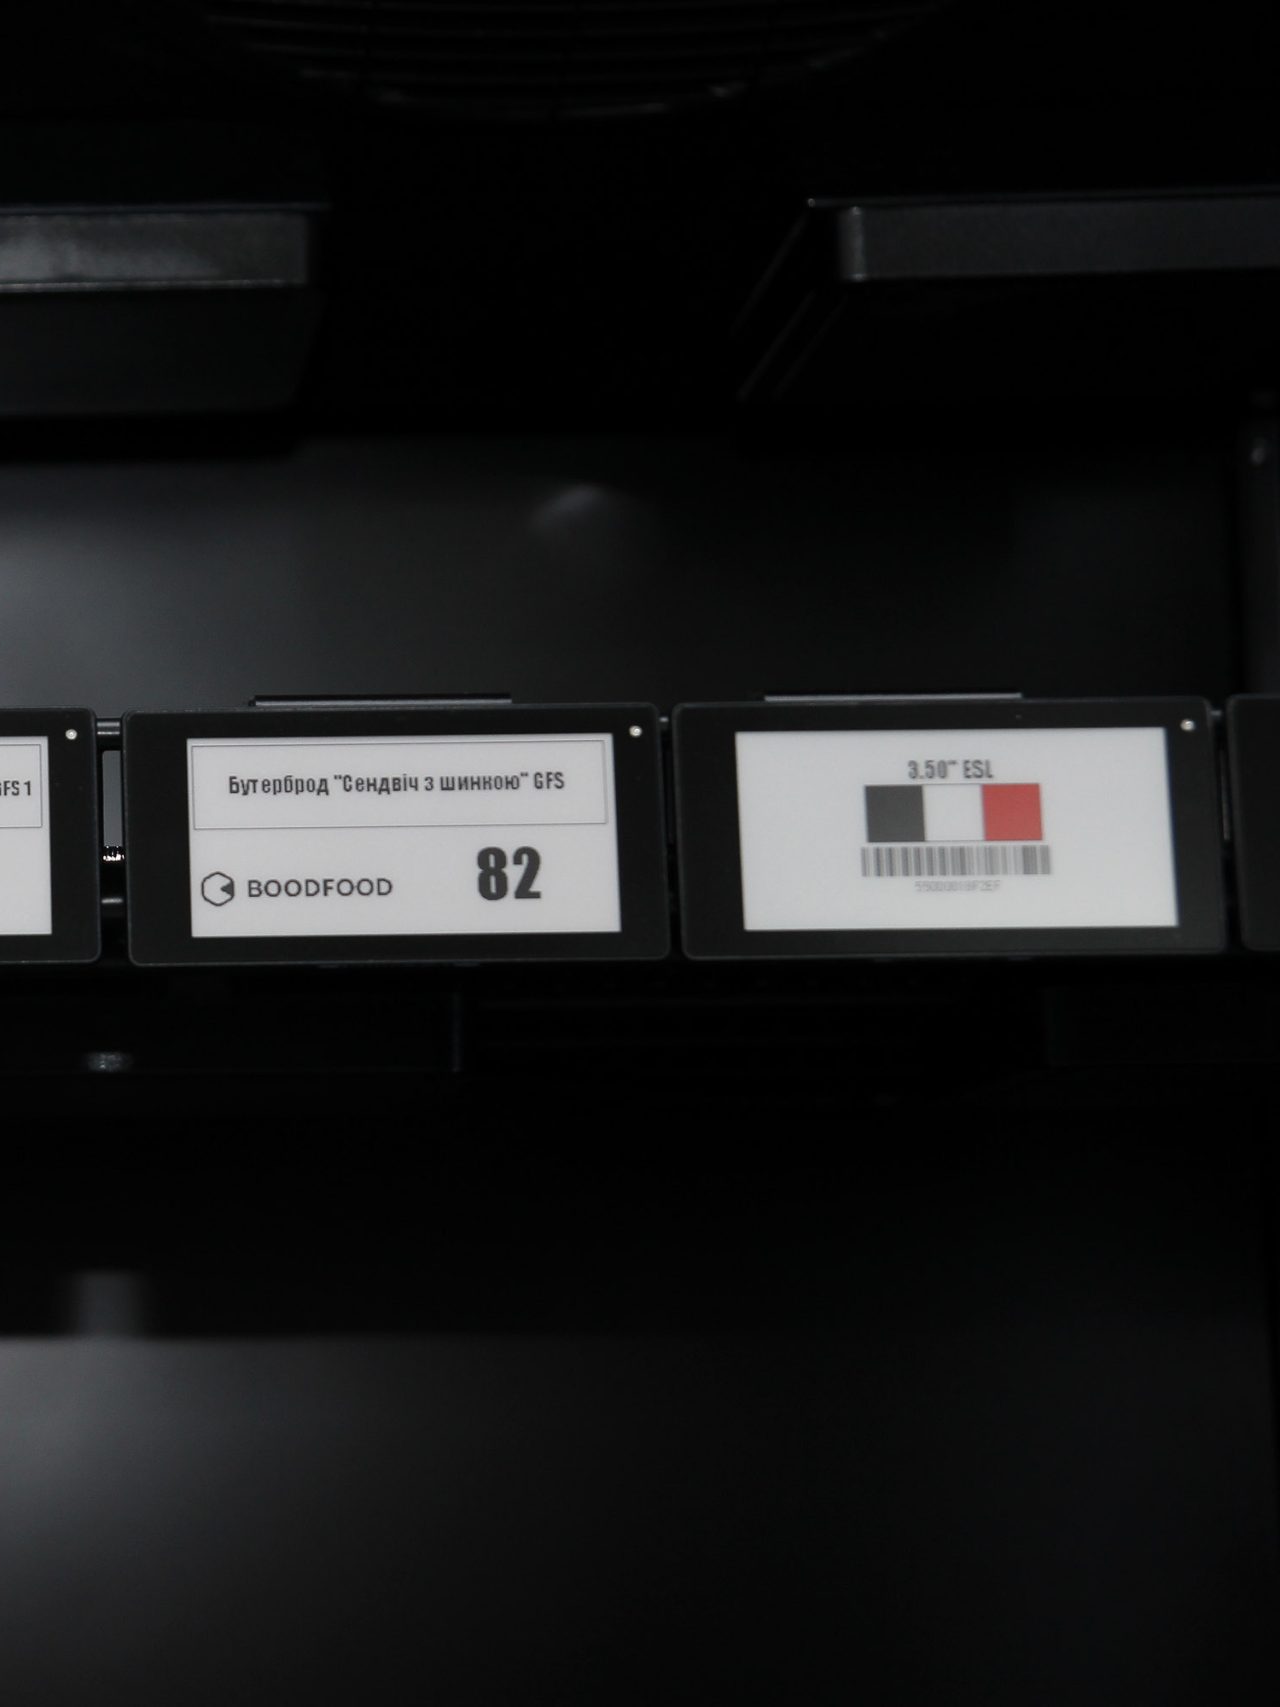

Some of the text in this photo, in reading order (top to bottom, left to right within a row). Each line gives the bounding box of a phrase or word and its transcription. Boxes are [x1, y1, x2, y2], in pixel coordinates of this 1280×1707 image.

[962, 759, 995, 780] ESL
[228, 774, 330, 797] Бутерброд
[423, 776, 435, 792] з
[533, 771, 565, 790] GFS
[476, 845, 542, 902] 82
[247, 877, 394, 898] BOODFOOD
